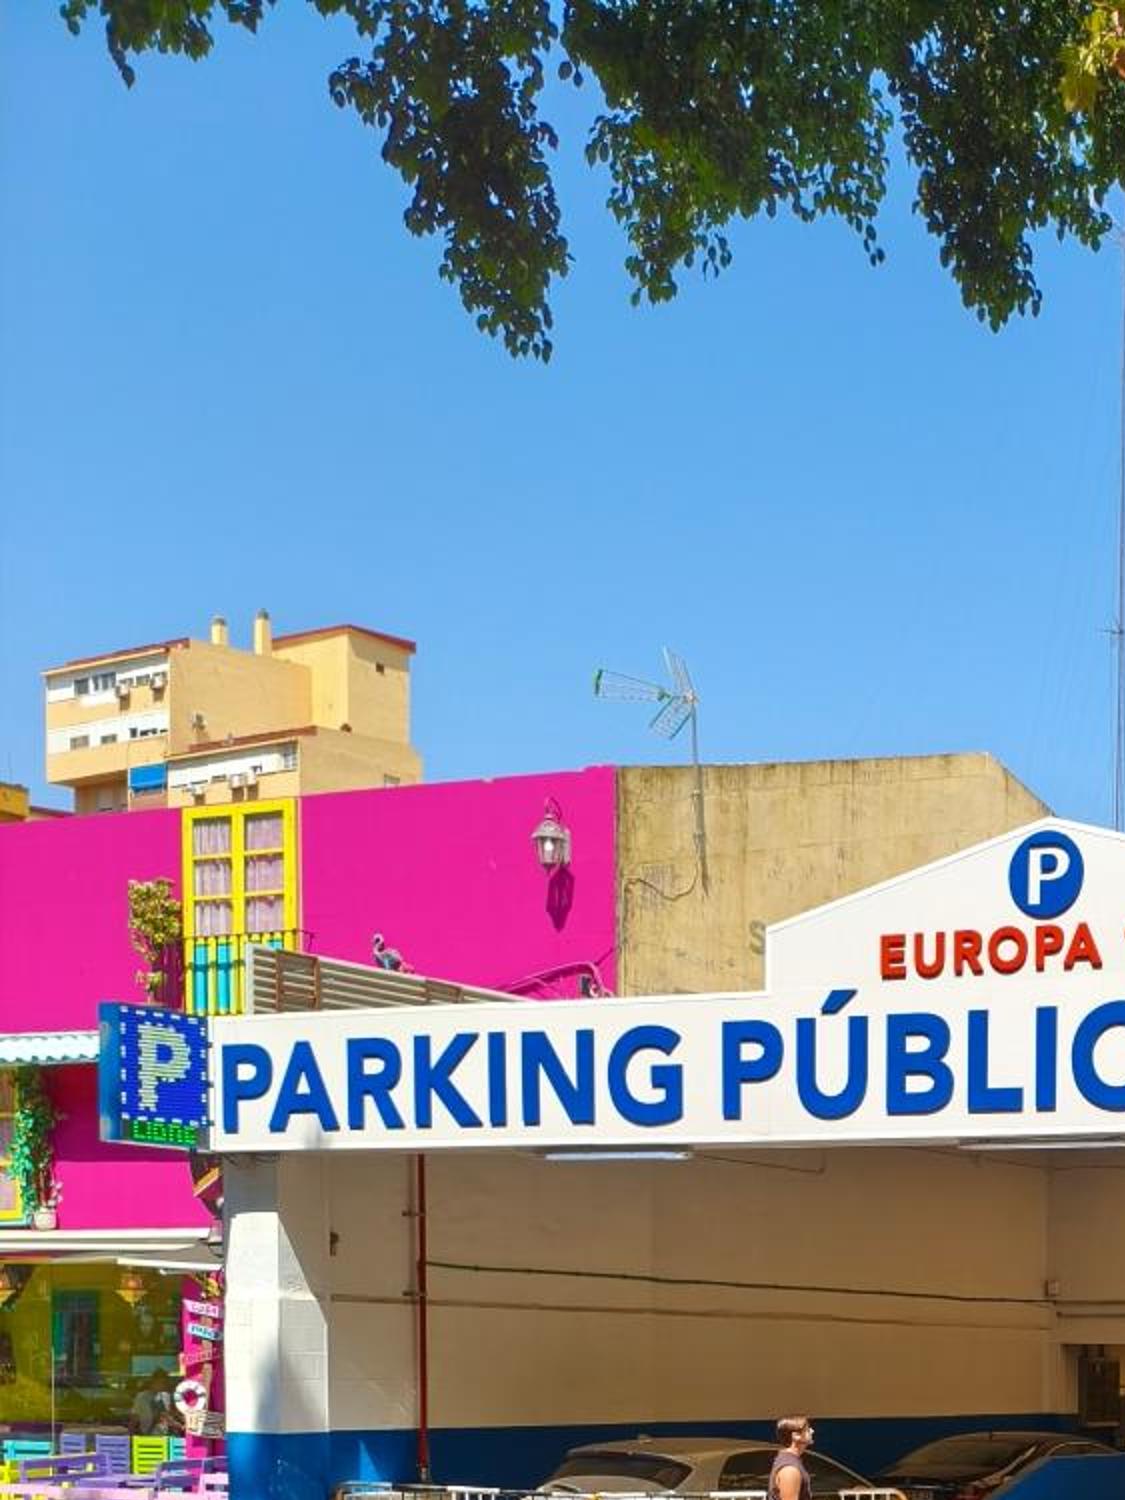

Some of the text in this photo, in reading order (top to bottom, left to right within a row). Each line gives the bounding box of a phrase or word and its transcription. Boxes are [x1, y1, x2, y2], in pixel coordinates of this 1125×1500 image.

[1027, 846, 1070, 906] P
[879, 922, 1102, 981] EUROPA
[137, 1021, 191, 1113] P
[220, 1024, 684, 1136] PARKING
